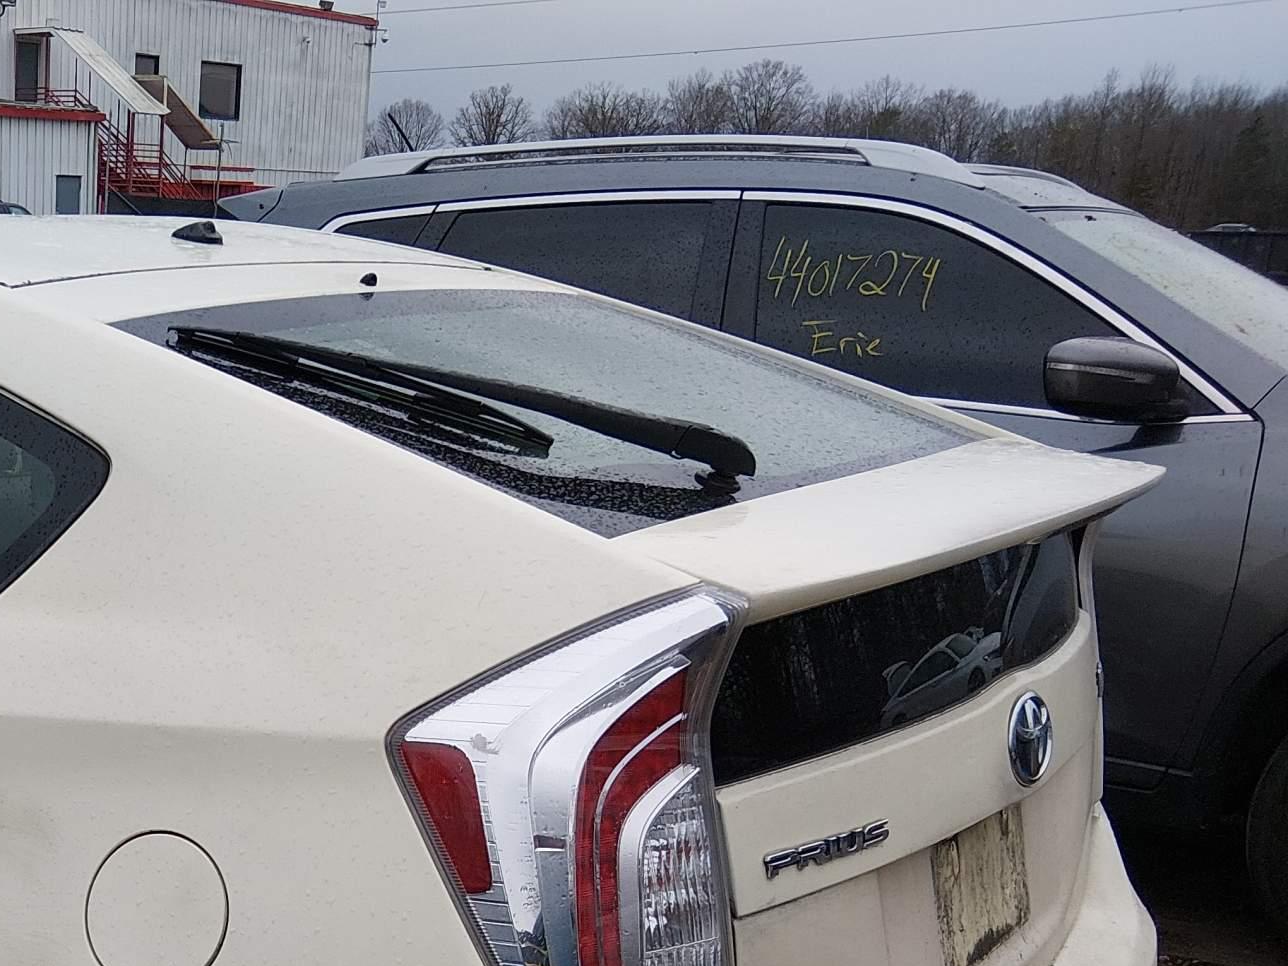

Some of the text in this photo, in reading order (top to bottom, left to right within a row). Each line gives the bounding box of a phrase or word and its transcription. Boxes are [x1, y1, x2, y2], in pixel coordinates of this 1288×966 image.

[767, 235, 941, 312] 44017274
[800, 319, 885, 359] Erie
[763, 818, 890, 880] PRIUS
